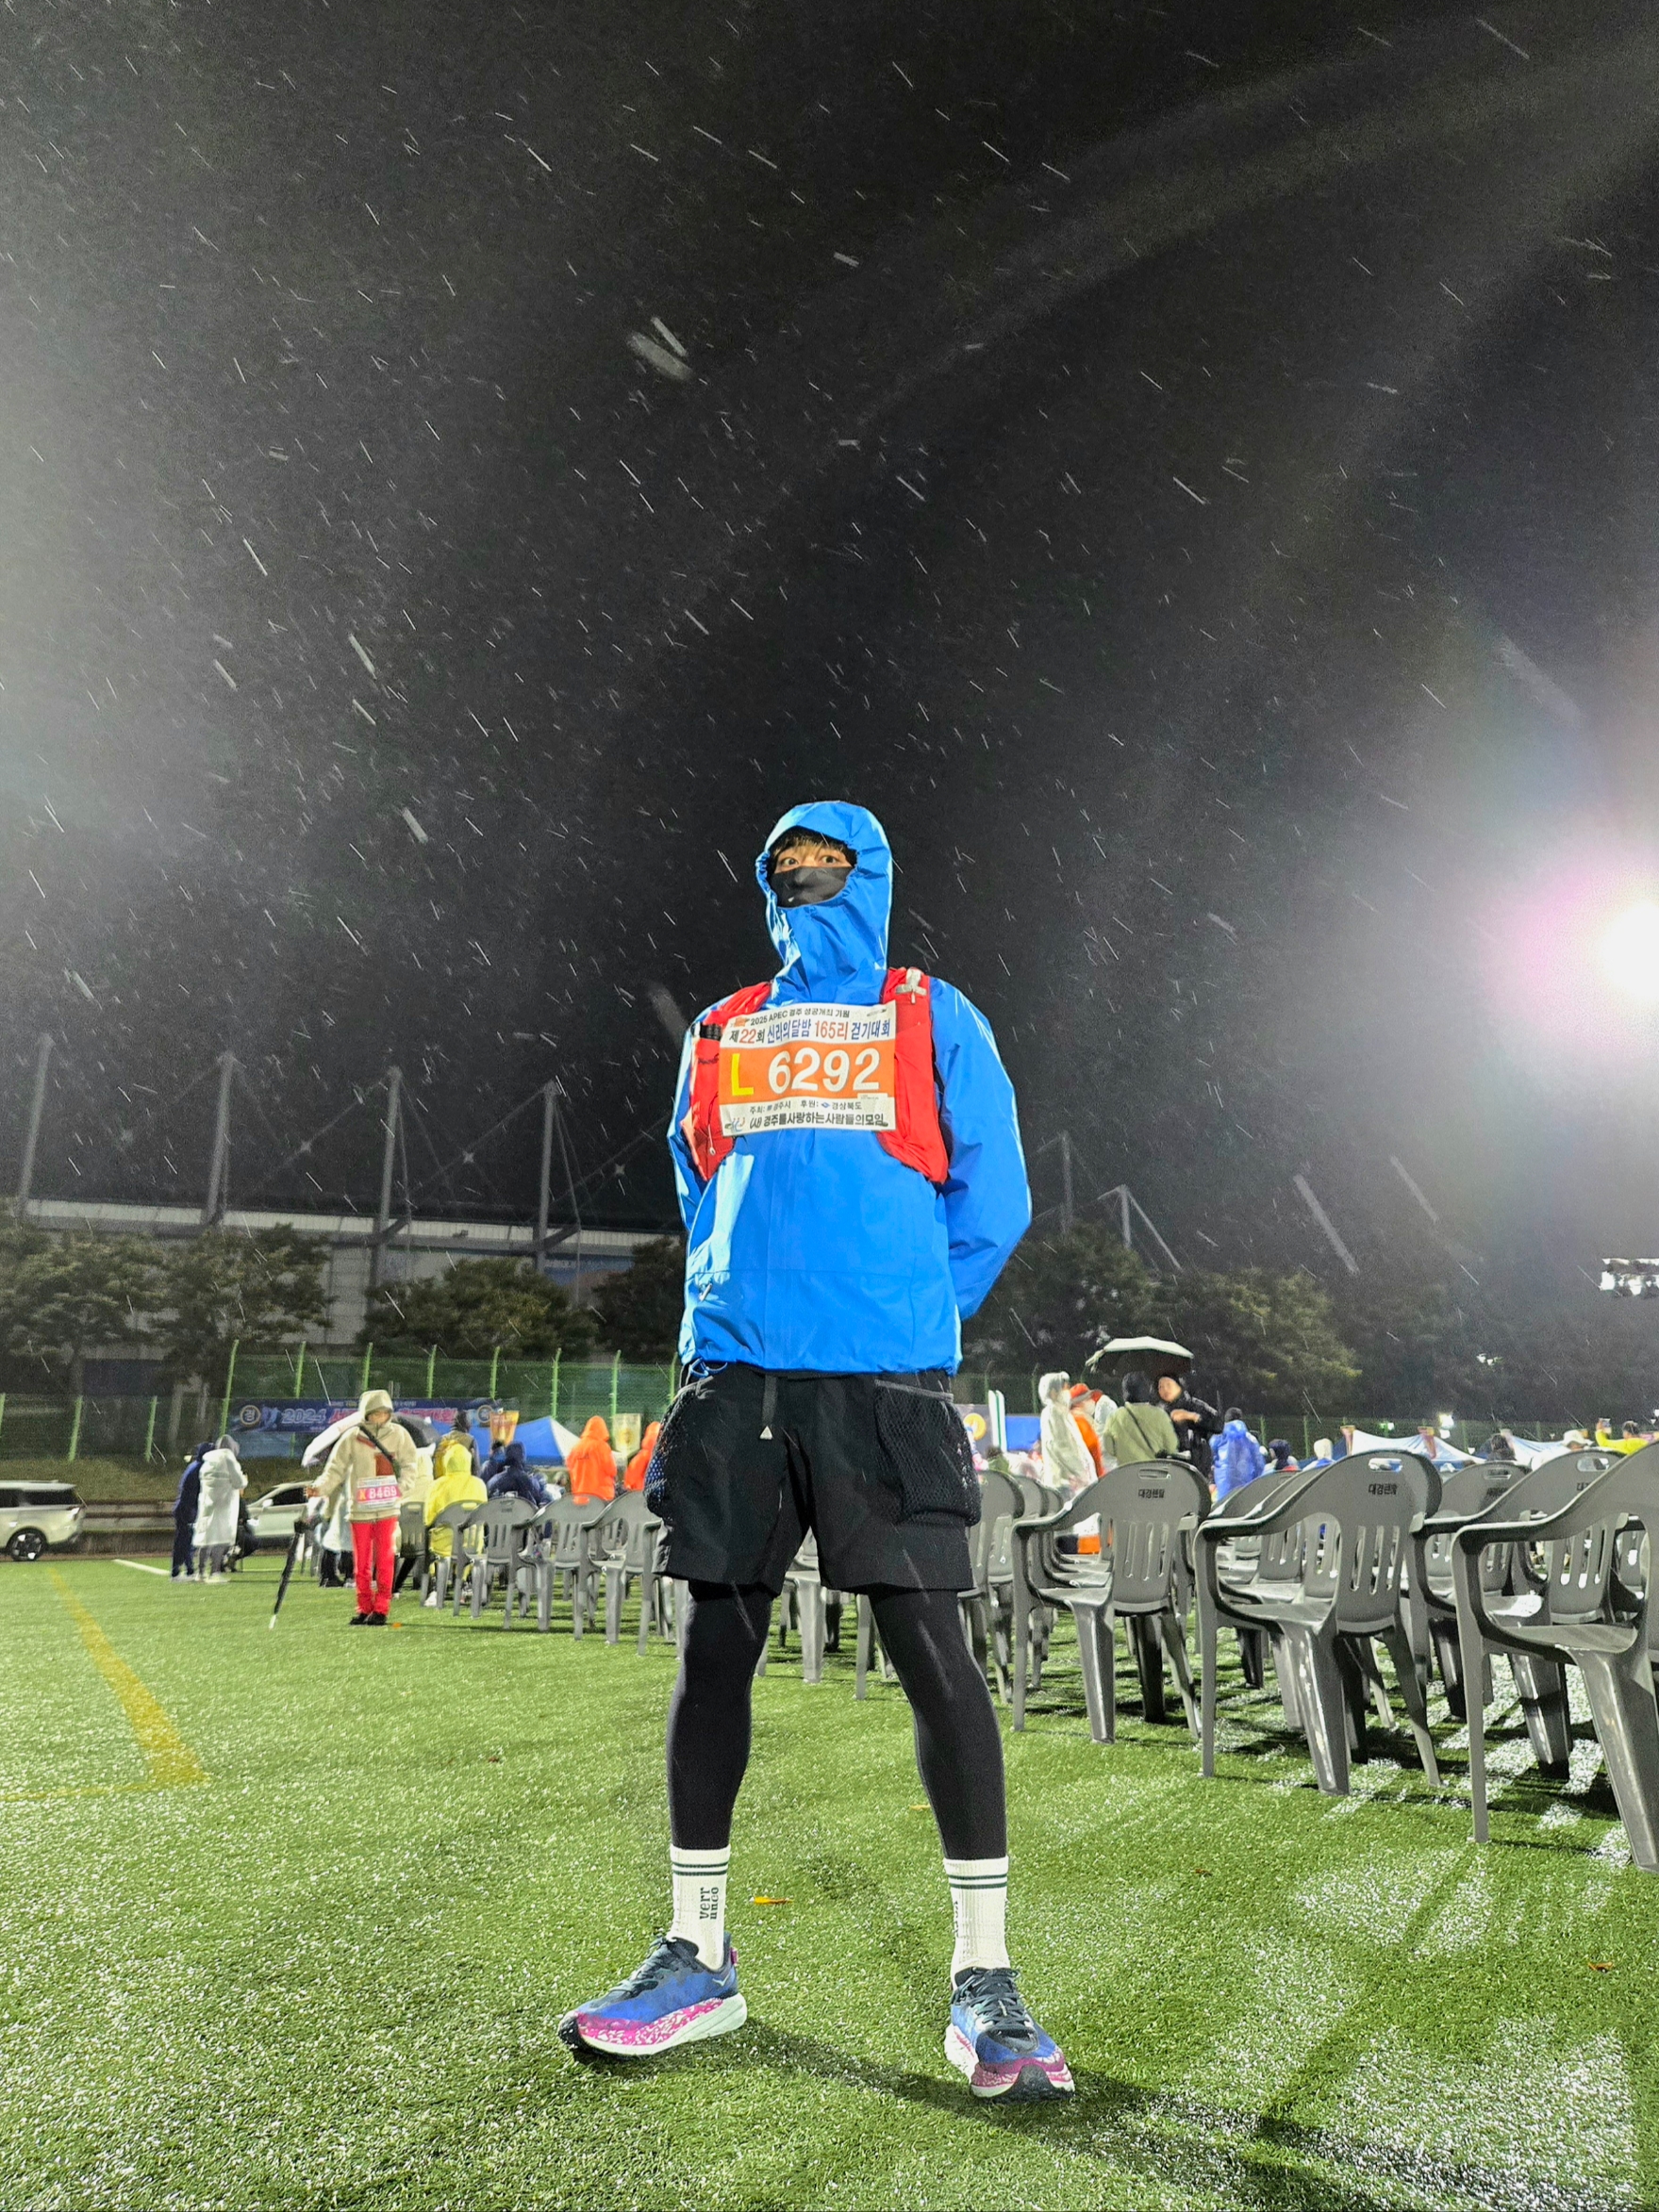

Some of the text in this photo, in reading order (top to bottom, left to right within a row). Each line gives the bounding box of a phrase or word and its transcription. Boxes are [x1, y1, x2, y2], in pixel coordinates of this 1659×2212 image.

[751, 1016, 768, 1026] 2025
[769, 1011, 788, 1022] APEC
[729, 1018, 890, 1044] 제22회 신라의달밤 165리 걷기대회
[731, 1048, 880, 1096] L 6292
[832, 1101, 862, 1111] 경상북도
[282, 1408, 327, 1424] 2024
[369, 1485, 397, 1499] 8469
